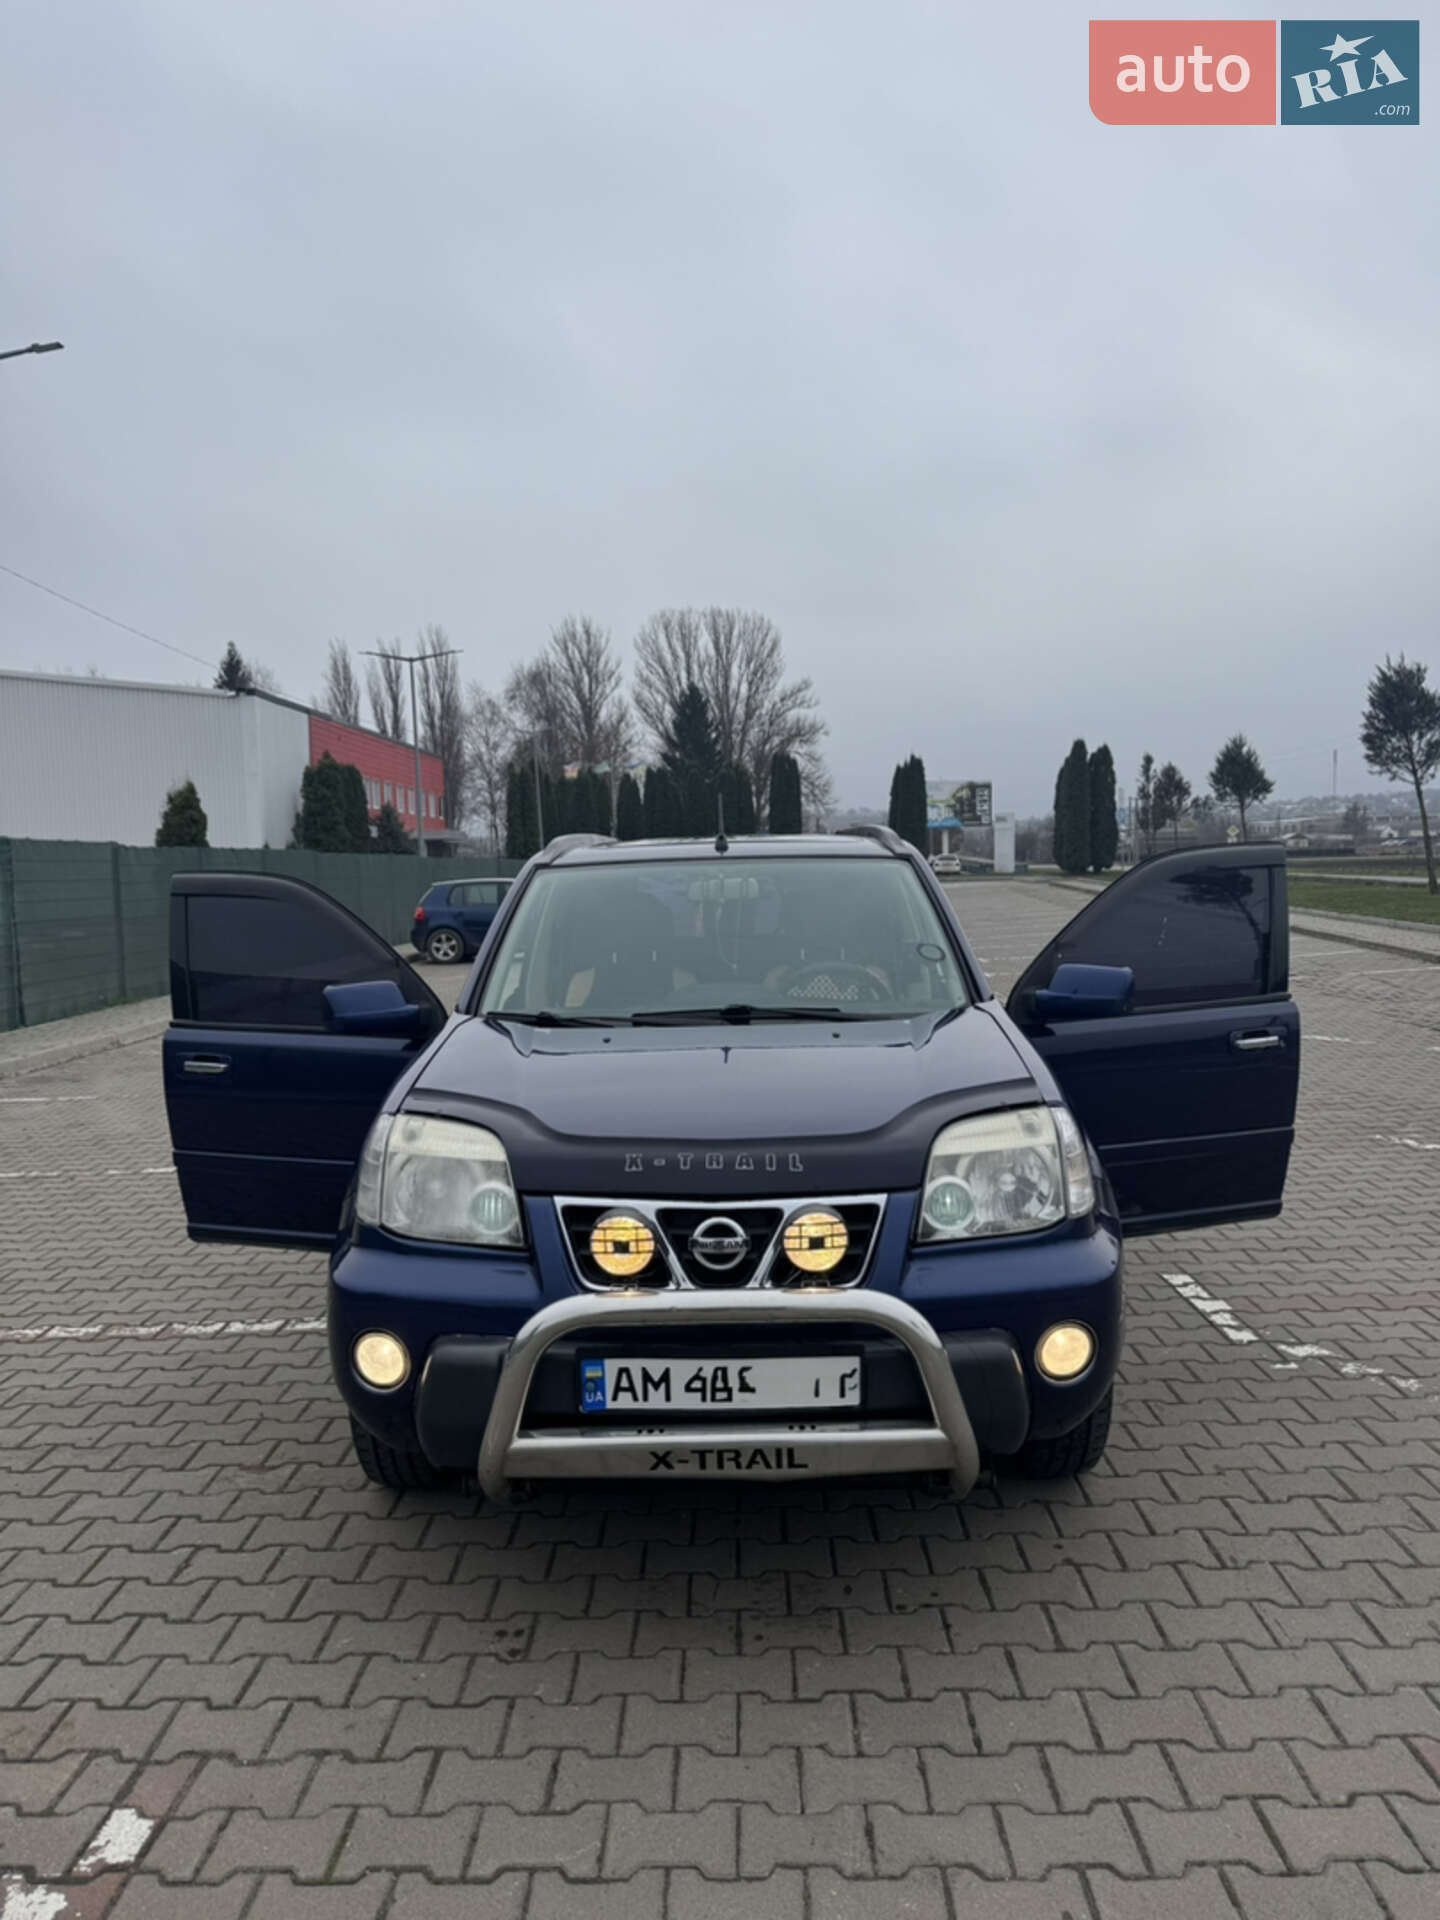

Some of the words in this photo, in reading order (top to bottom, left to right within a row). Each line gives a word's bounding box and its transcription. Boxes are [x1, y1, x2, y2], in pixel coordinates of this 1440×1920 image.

[624, 1152, 804, 1172] X-TRAIL
[611, 1366, 671, 1403] AM
[649, 1447, 809, 1471] X-TRAIL
